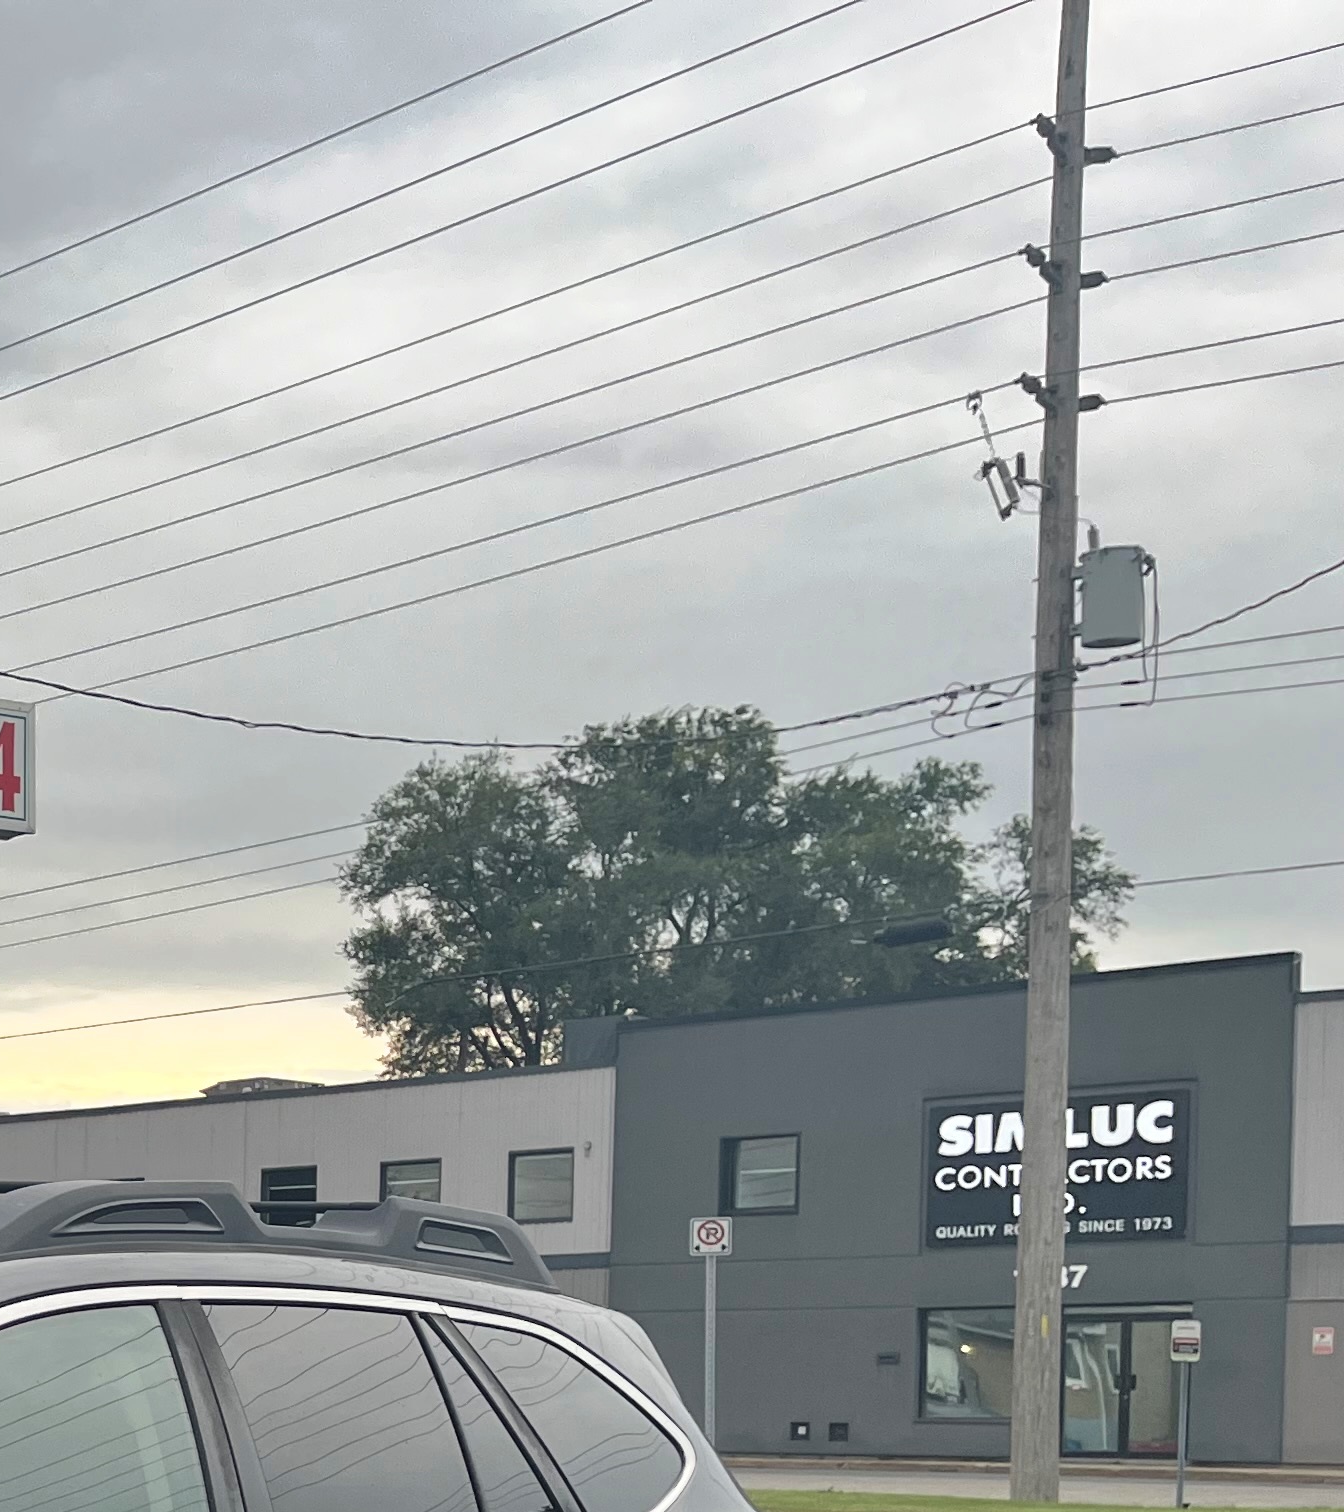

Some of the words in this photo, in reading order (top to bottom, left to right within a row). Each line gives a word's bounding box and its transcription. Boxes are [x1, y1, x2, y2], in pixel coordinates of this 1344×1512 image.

[934, 1154, 1172, 1191] CONTCTORS
[935, 1224, 997, 1239] QUALITY
[1078, 1218, 1125, 1234] SINCE
[1134, 1216, 1173, 1231] 1973
